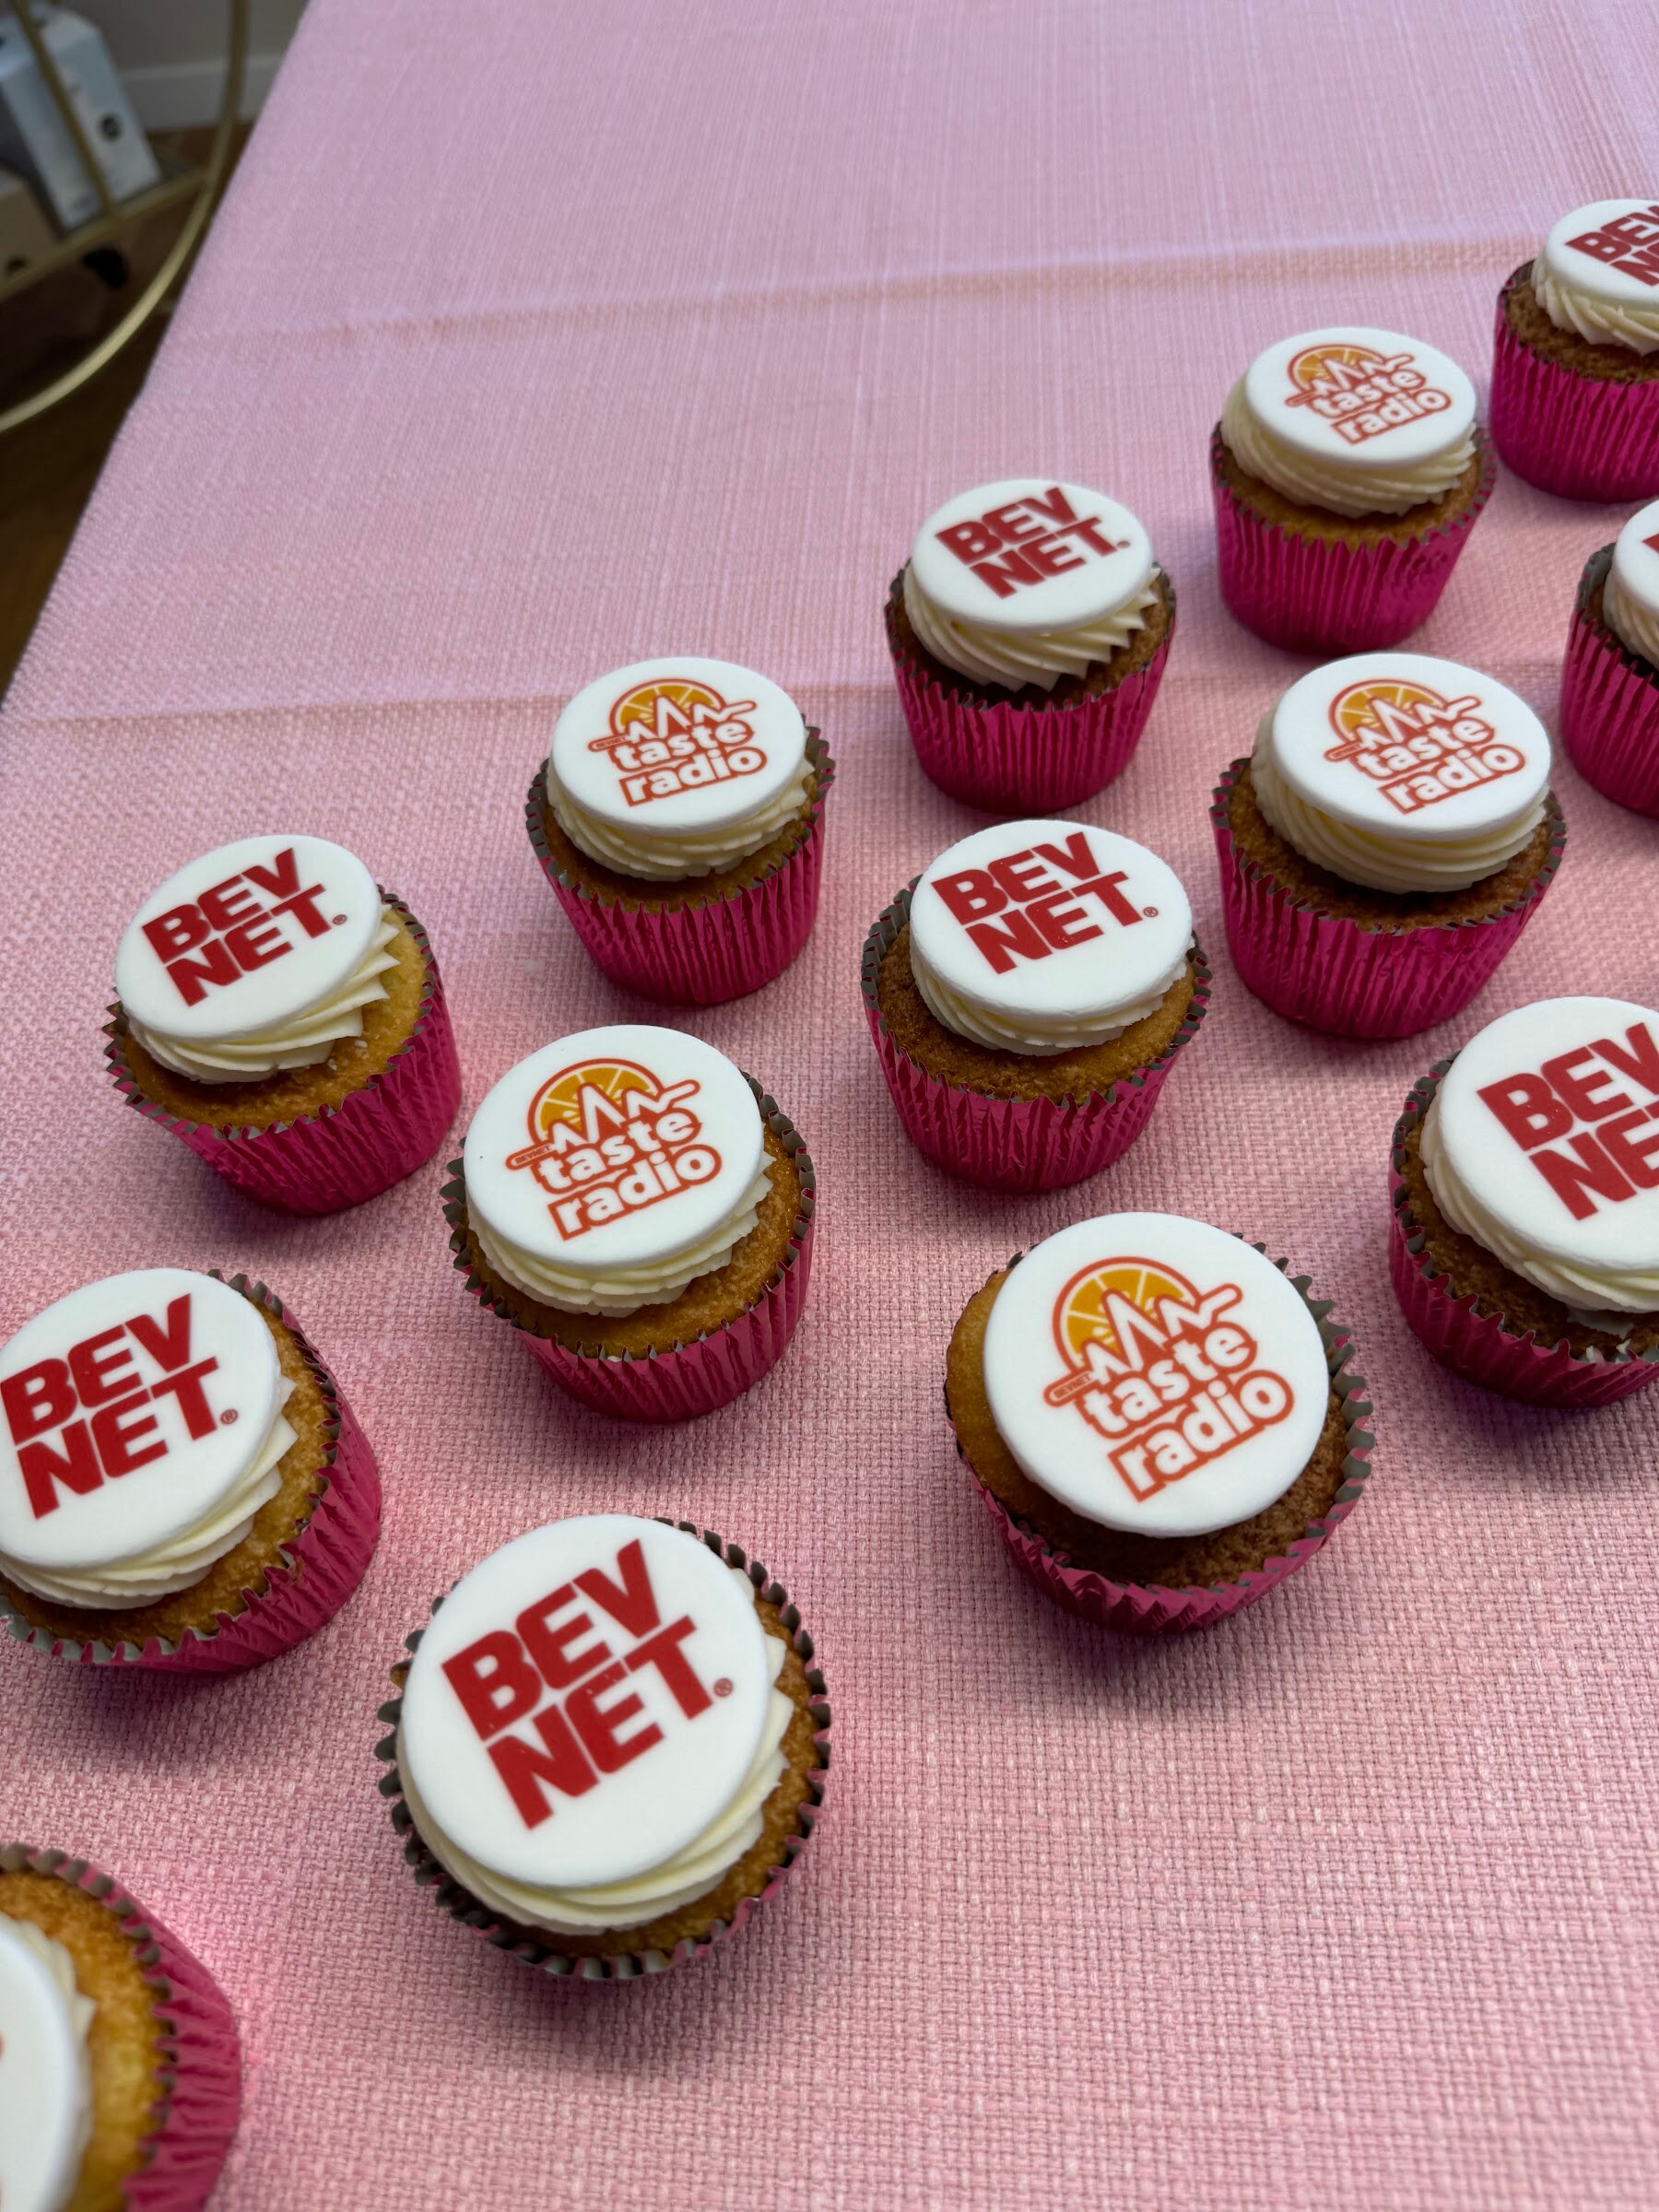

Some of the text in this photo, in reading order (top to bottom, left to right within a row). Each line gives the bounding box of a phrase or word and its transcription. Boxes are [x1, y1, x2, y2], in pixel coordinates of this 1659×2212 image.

[1311, 371, 1424, 417] taste
[1335, 390, 1449, 442] radio
[935, 488, 1077, 566] BEV
[613, 721, 749, 770] taste
[622, 747, 764, 804] radio
[1355, 718, 1492, 778] taste
[1383, 746, 1522, 811] radio
[142, 848, 300, 963] BEV
[931, 831, 1100, 925] BEV
[1476, 1022, 1659, 1151] BEV
[536, 1111, 695, 1190] taste
[553, 1147, 717, 1236] radio
[1528, 1101, 1659, 1221] NE
[0, 1293, 191, 1446] BEV
[1082, 1325, 1253, 1435] taste
[1114, 1373, 1289, 1497] radio
[441, 1538, 661, 1742] BEV
